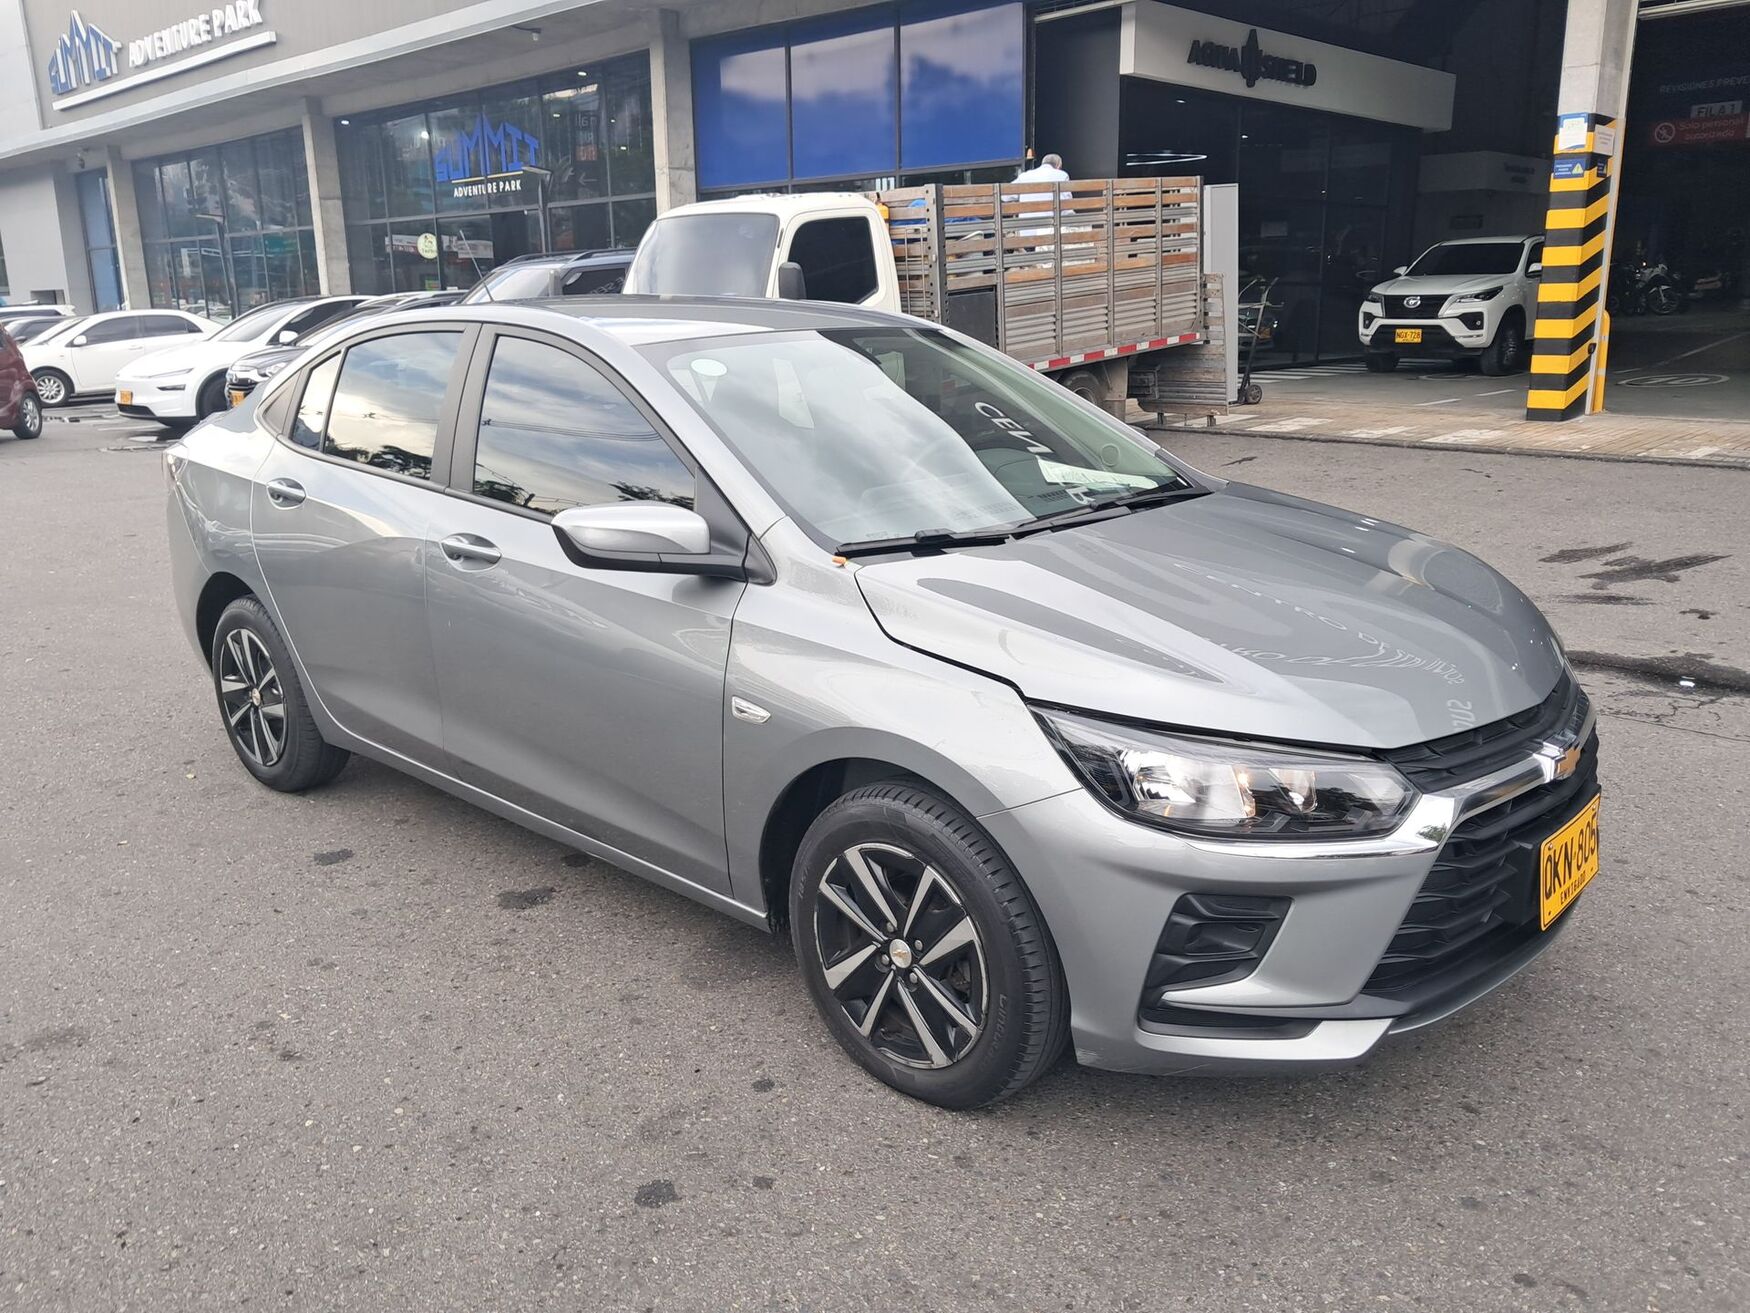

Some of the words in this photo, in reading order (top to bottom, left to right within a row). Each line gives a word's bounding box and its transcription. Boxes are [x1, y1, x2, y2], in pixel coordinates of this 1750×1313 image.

[129, 14, 212, 68] ADVENTURE
[212, 0, 263, 37] PARK
[453, 182, 497, 198] ADVENTURE
[499, 179, 522, 192] PARK
